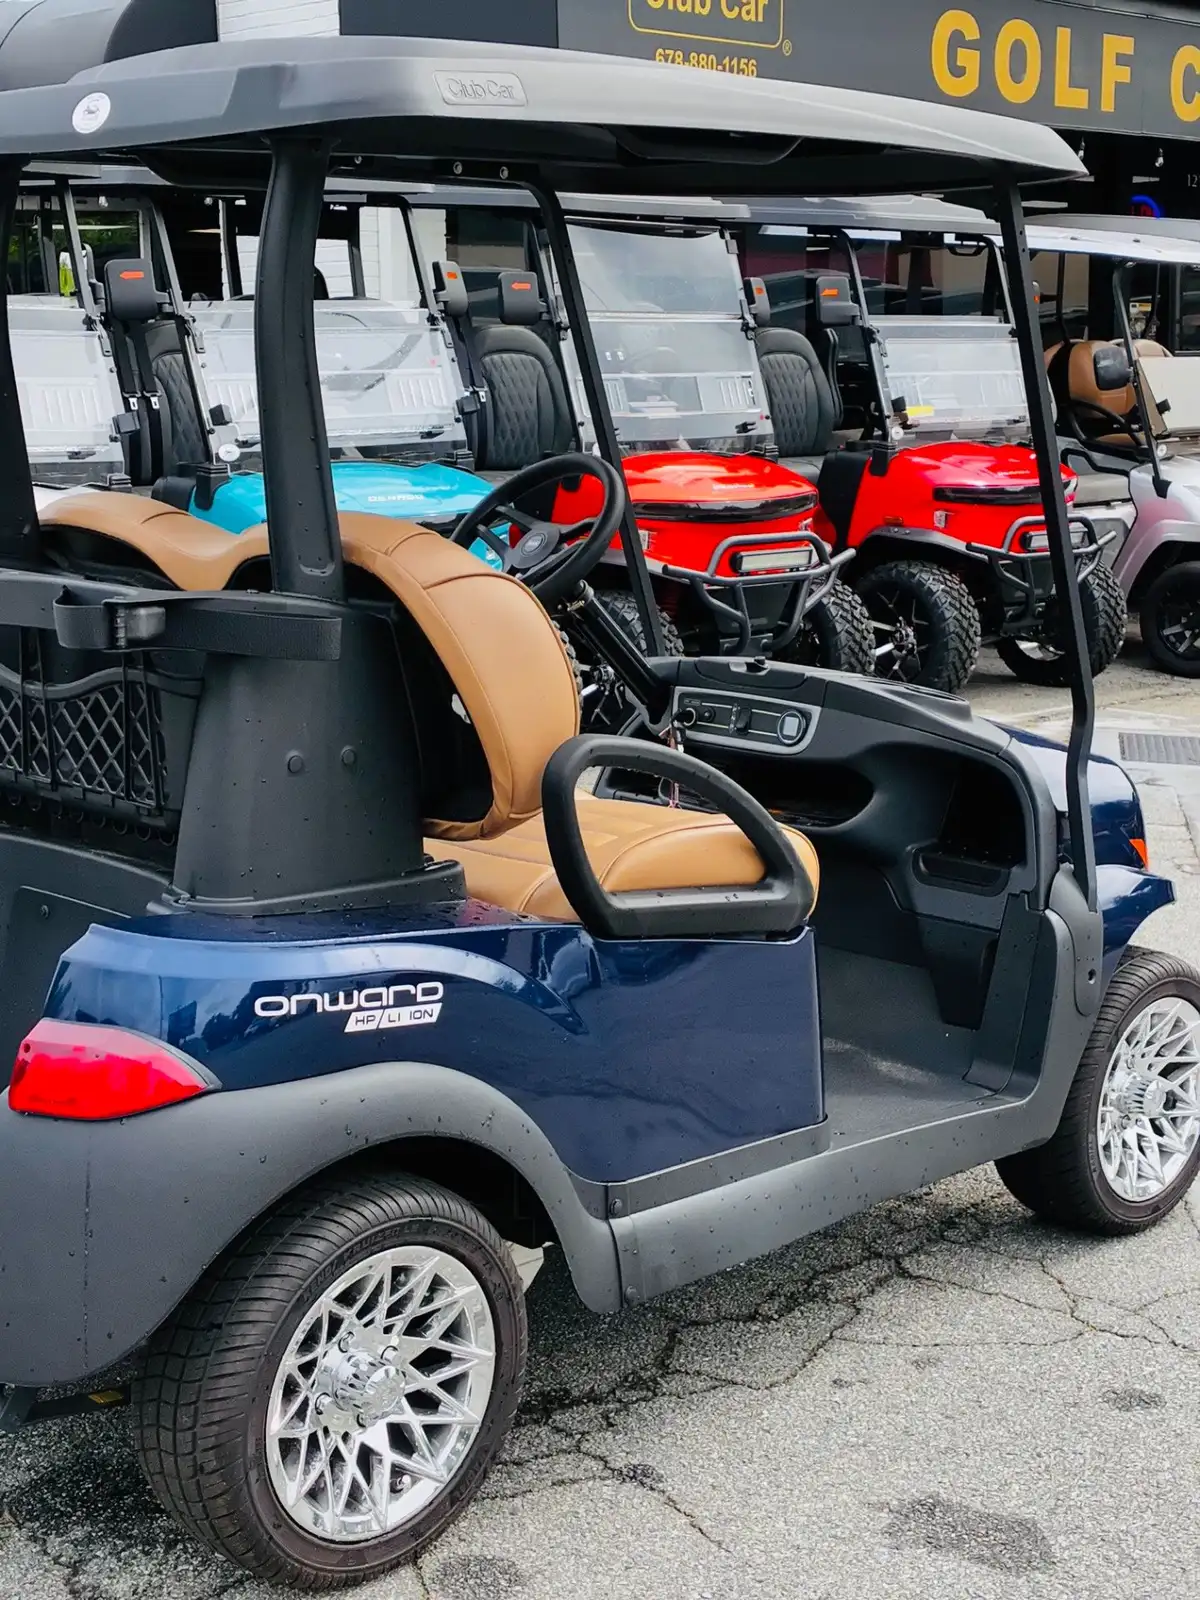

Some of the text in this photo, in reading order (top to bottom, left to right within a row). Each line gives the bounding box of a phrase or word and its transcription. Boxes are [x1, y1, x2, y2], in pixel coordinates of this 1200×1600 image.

[655, 48, 757, 78] 678-880-1156
[931, 9, 1135, 112] GOLF
[447, 78, 514, 98] Club Car
[1187, 174, 1200, 187] 12
[409, 1008, 434, 1021] ION
